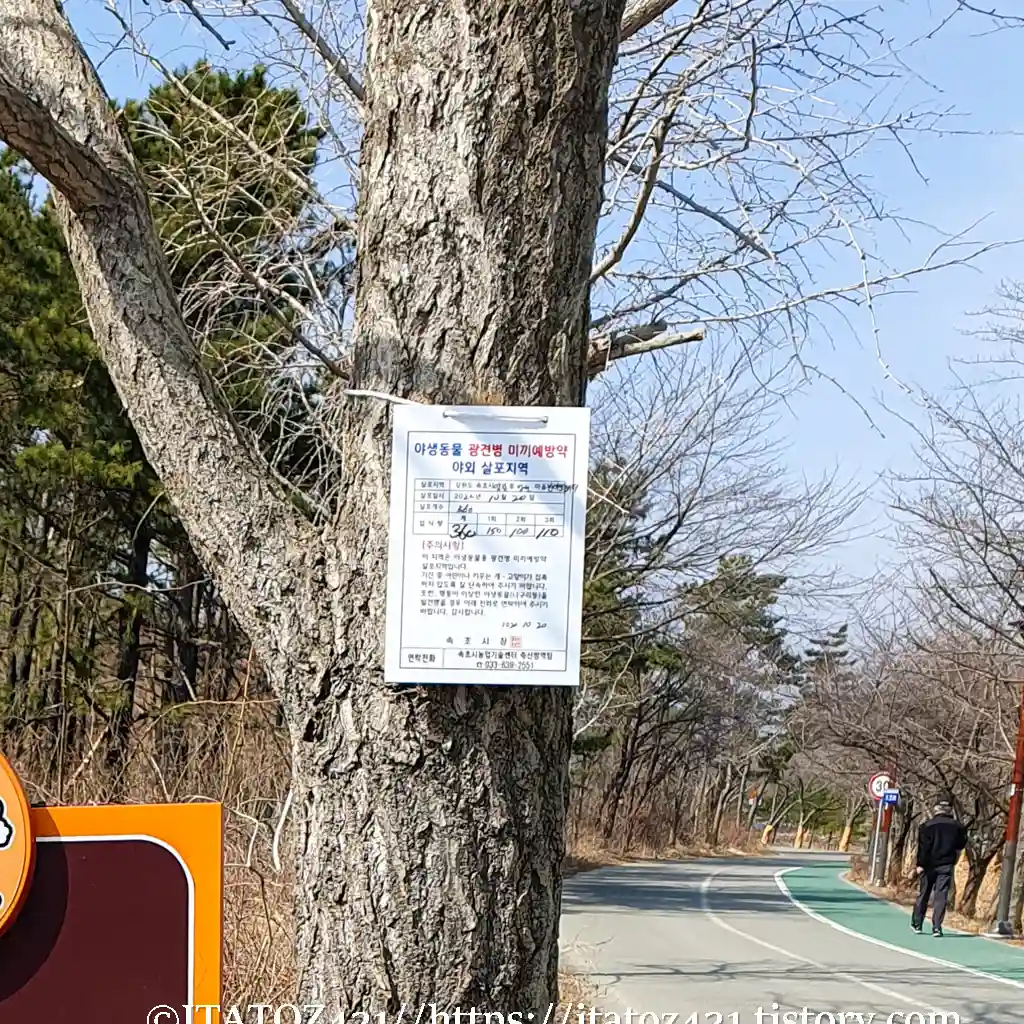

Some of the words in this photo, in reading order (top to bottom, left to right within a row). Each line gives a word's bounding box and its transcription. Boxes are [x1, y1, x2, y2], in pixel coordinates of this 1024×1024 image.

[414, 442, 463, 456] 야생동물
[468, 443, 503, 457] 광견병
[508, 444, 568, 459] 미끼예방약
[452, 461, 476, 474] 야외
[481, 462, 529, 475] 살포지역
[449, 523, 477, 539] 360
[486, 526, 502, 535] 150
